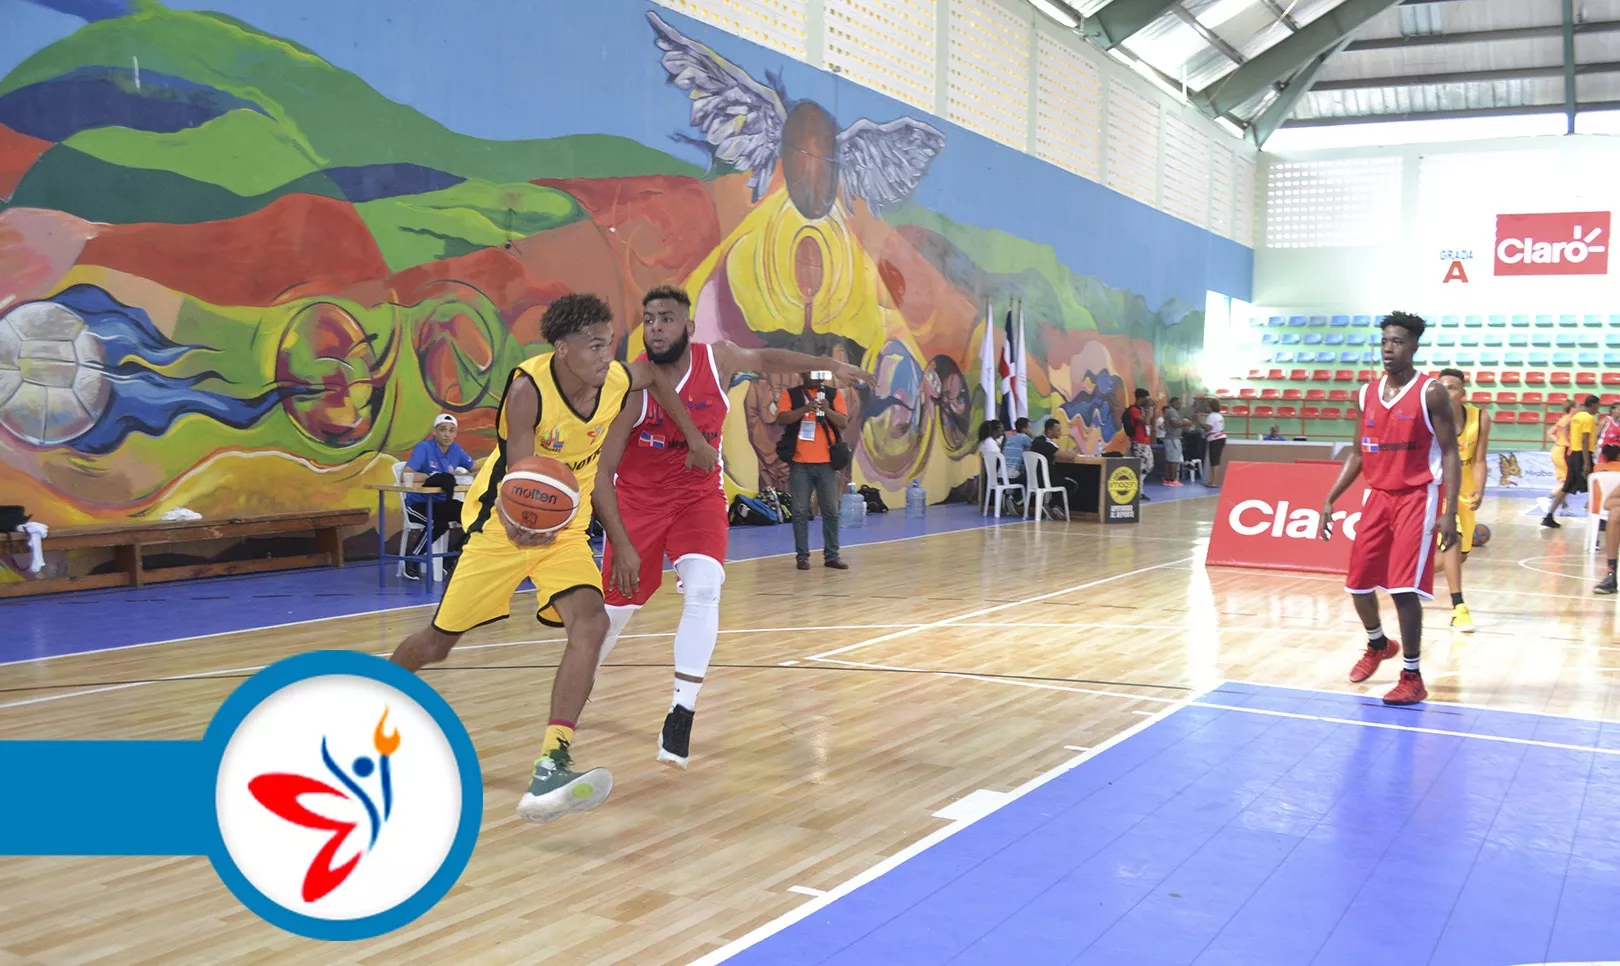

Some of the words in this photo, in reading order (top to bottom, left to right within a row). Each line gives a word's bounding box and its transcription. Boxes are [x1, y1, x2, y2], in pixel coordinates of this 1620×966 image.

[1497, 235, 1592, 264] Claro
[1442, 260, 1469, 283] A
[511, 485, 557, 505] molten
